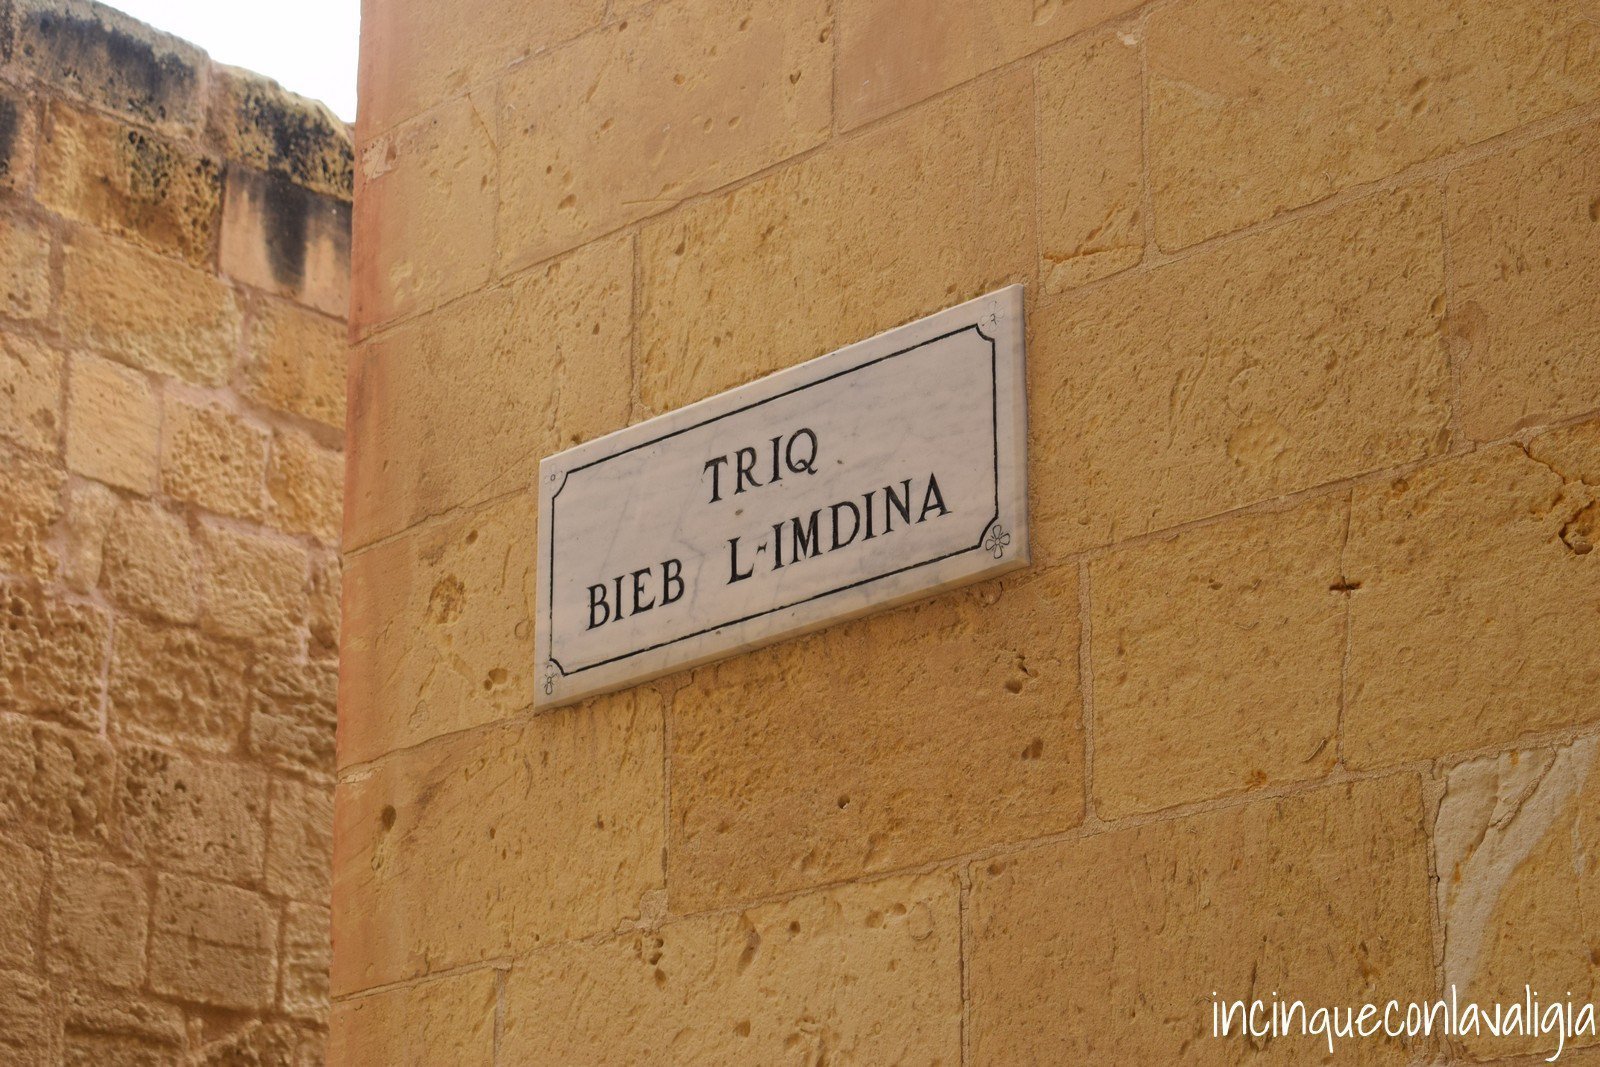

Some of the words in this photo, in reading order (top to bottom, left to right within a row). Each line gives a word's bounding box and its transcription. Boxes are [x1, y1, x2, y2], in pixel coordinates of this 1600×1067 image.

[703, 427, 818, 504] TRIQ
[586, 558, 685, 631] BIEB
[726, 473, 952, 585] L-IMDINA
